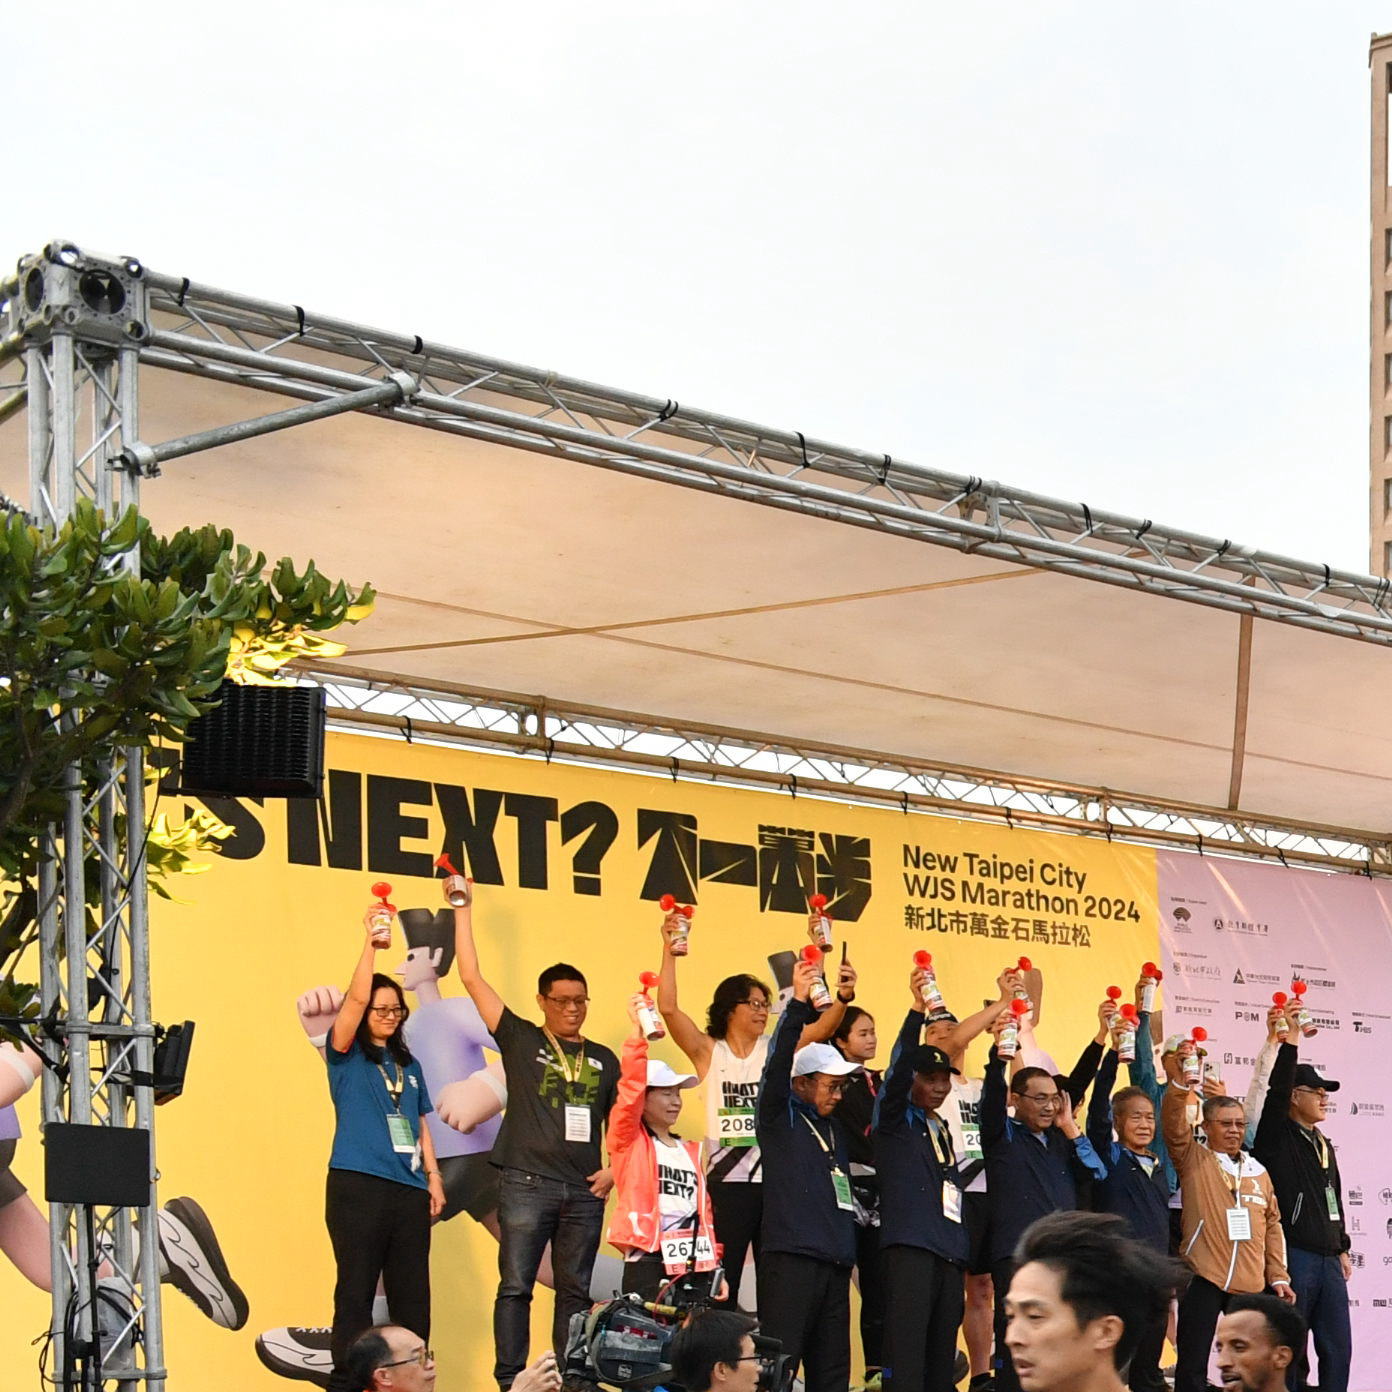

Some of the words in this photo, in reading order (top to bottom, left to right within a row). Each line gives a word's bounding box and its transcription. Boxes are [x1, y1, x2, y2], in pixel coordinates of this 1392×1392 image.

[287, 769, 618, 896] NEXT?
[903, 844, 958, 873] New
[963, 852, 1034, 884] Taipei
[1040, 863, 1086, 894] City
[903, 872, 956, 901] WJS
[961, 880, 1078, 915] Marathon
[1084, 896, 1140, 923] 2024
[904, 904, 1091, 948] 新北市萬金石馬拉松
